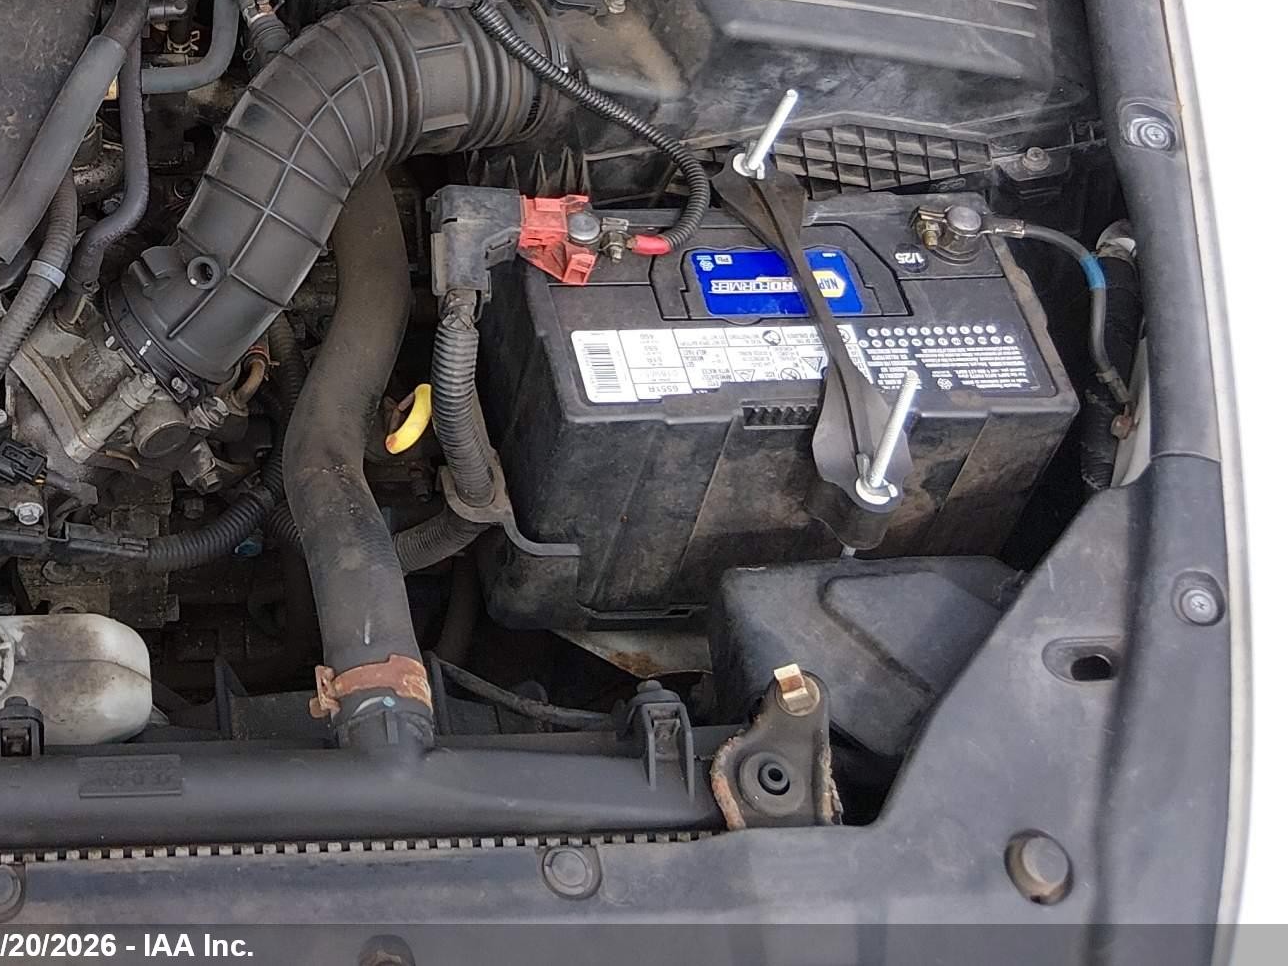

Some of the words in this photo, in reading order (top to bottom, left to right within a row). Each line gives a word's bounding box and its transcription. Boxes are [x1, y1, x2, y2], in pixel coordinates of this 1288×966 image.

[894, 252, 925, 264] 1/25
[711, 280, 799, 292] ROFORMER
[818, 278, 839, 290] NAP
